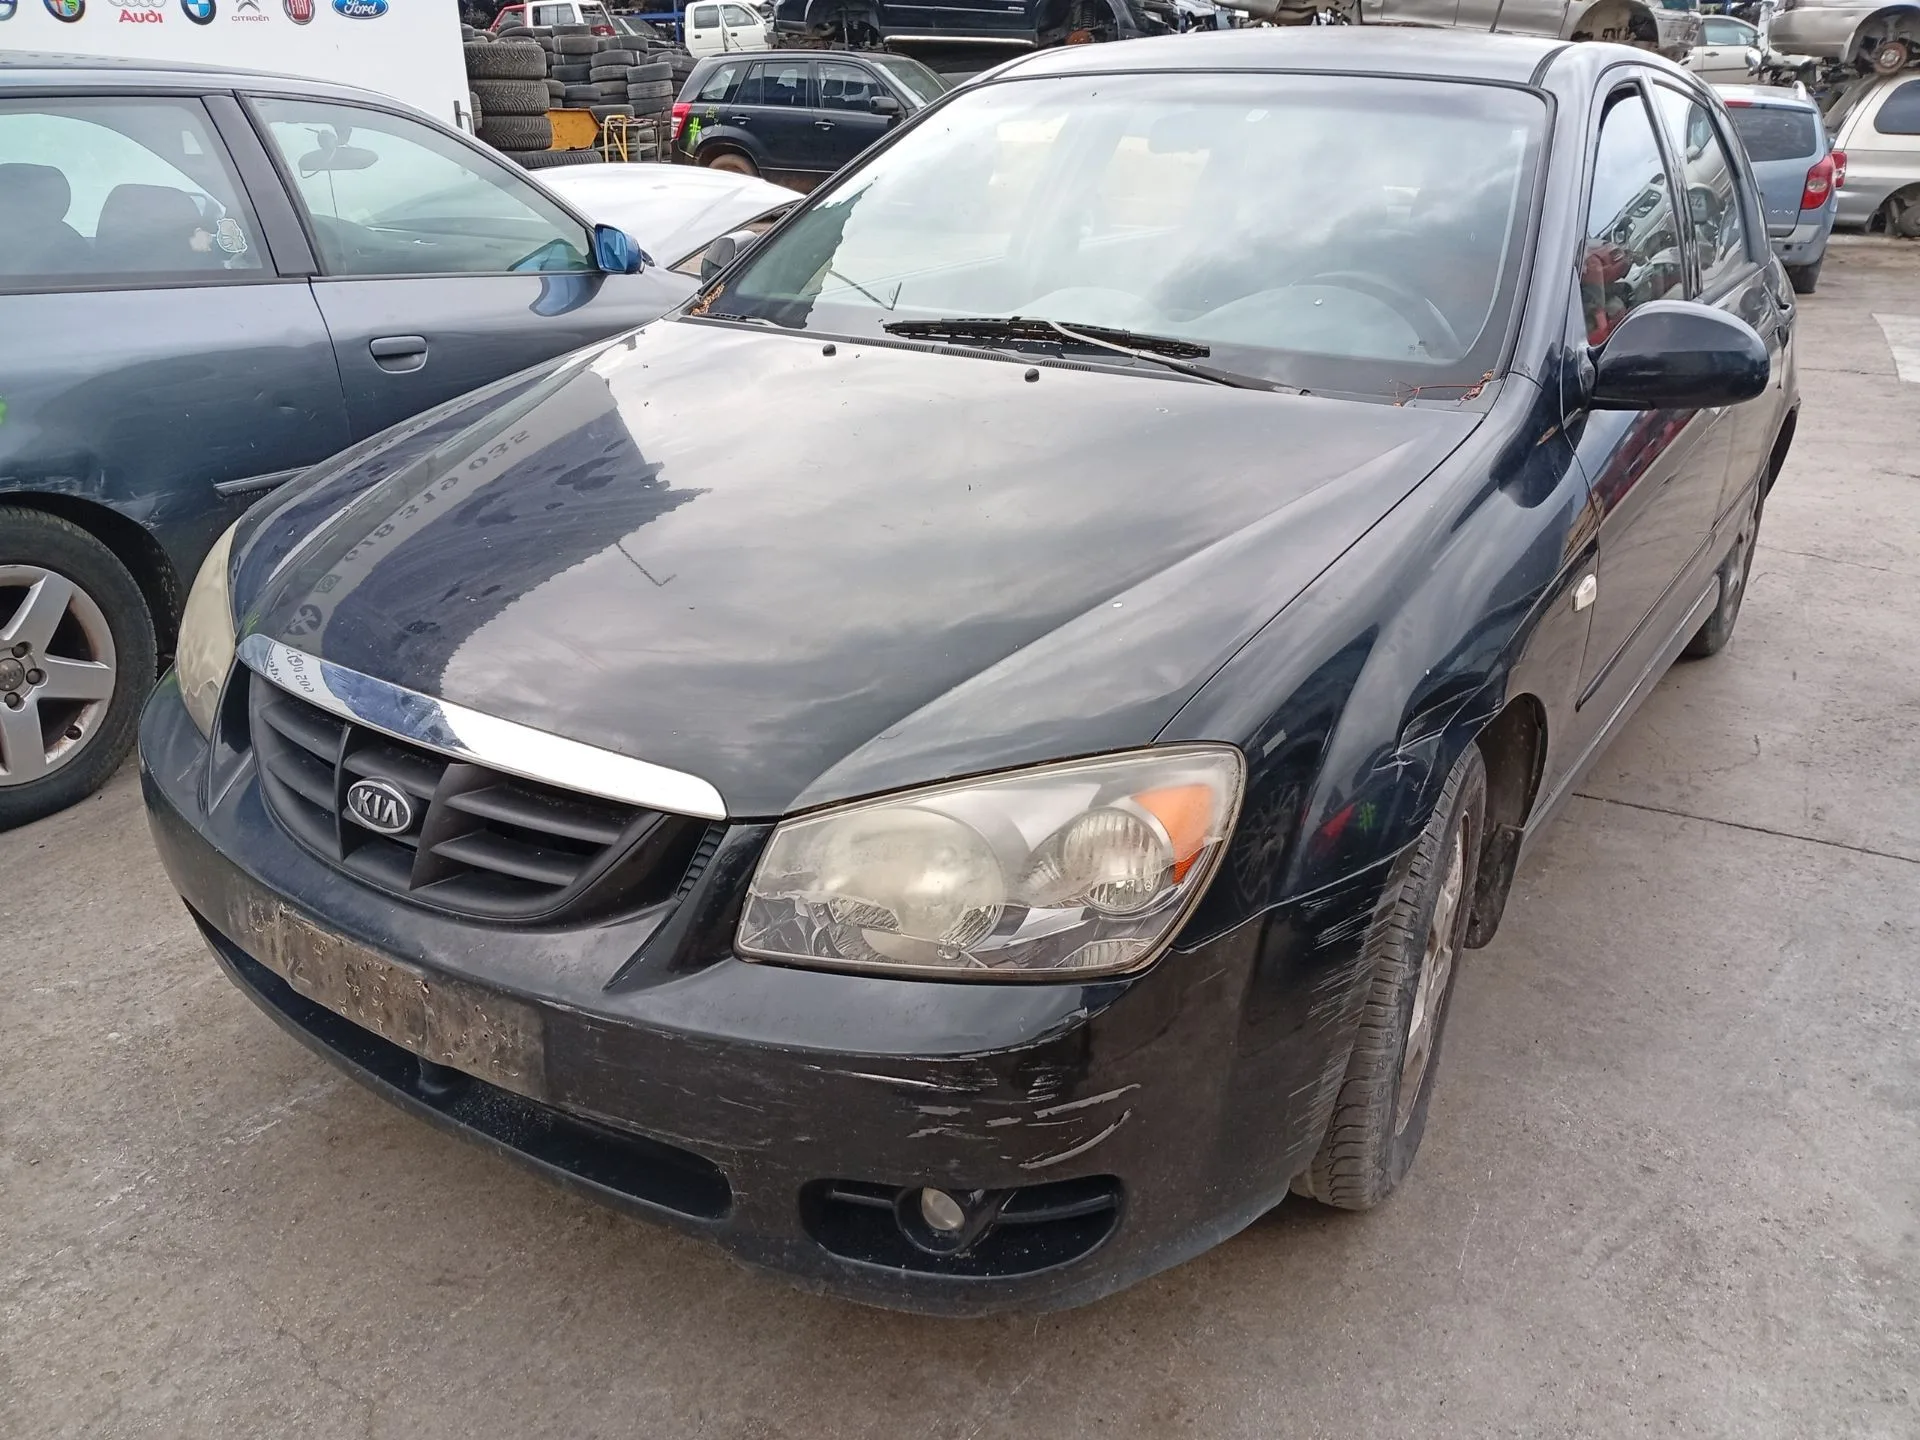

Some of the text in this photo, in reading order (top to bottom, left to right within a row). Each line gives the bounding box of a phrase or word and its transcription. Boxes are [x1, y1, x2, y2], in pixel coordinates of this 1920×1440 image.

[344, 0, 377, 14] Ford
[118, 9, 163, 23] Audi
[357, 788, 399, 827] KIA
